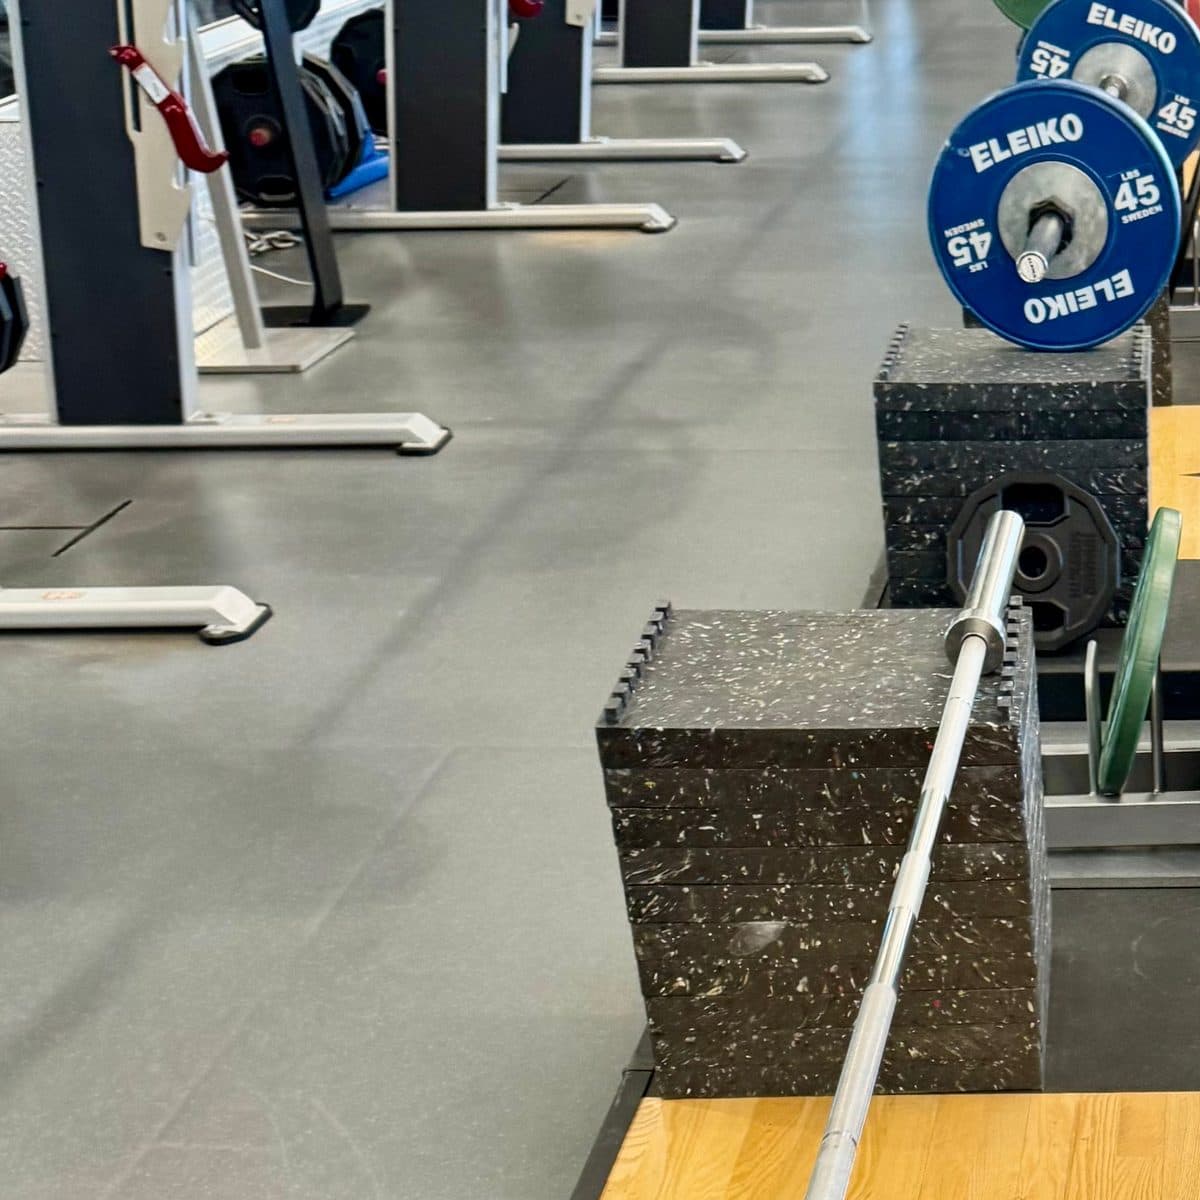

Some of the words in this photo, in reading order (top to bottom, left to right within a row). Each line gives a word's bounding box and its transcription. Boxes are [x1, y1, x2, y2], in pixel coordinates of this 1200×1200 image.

[1087, 2, 1177, 55] ELEIKO
[1030, 48, 1070, 78] 45
[1158, 101, 1197, 132] 45
[968, 113, 1084, 173] ELEIKO
[1114, 174, 1160, 212] 45
[944, 218, 985, 238] SWEDEN
[1121, 204, 1163, 224] SWEDEN
[947, 231, 992, 267] 45
[1024, 269, 1135, 324] ELEIKO
